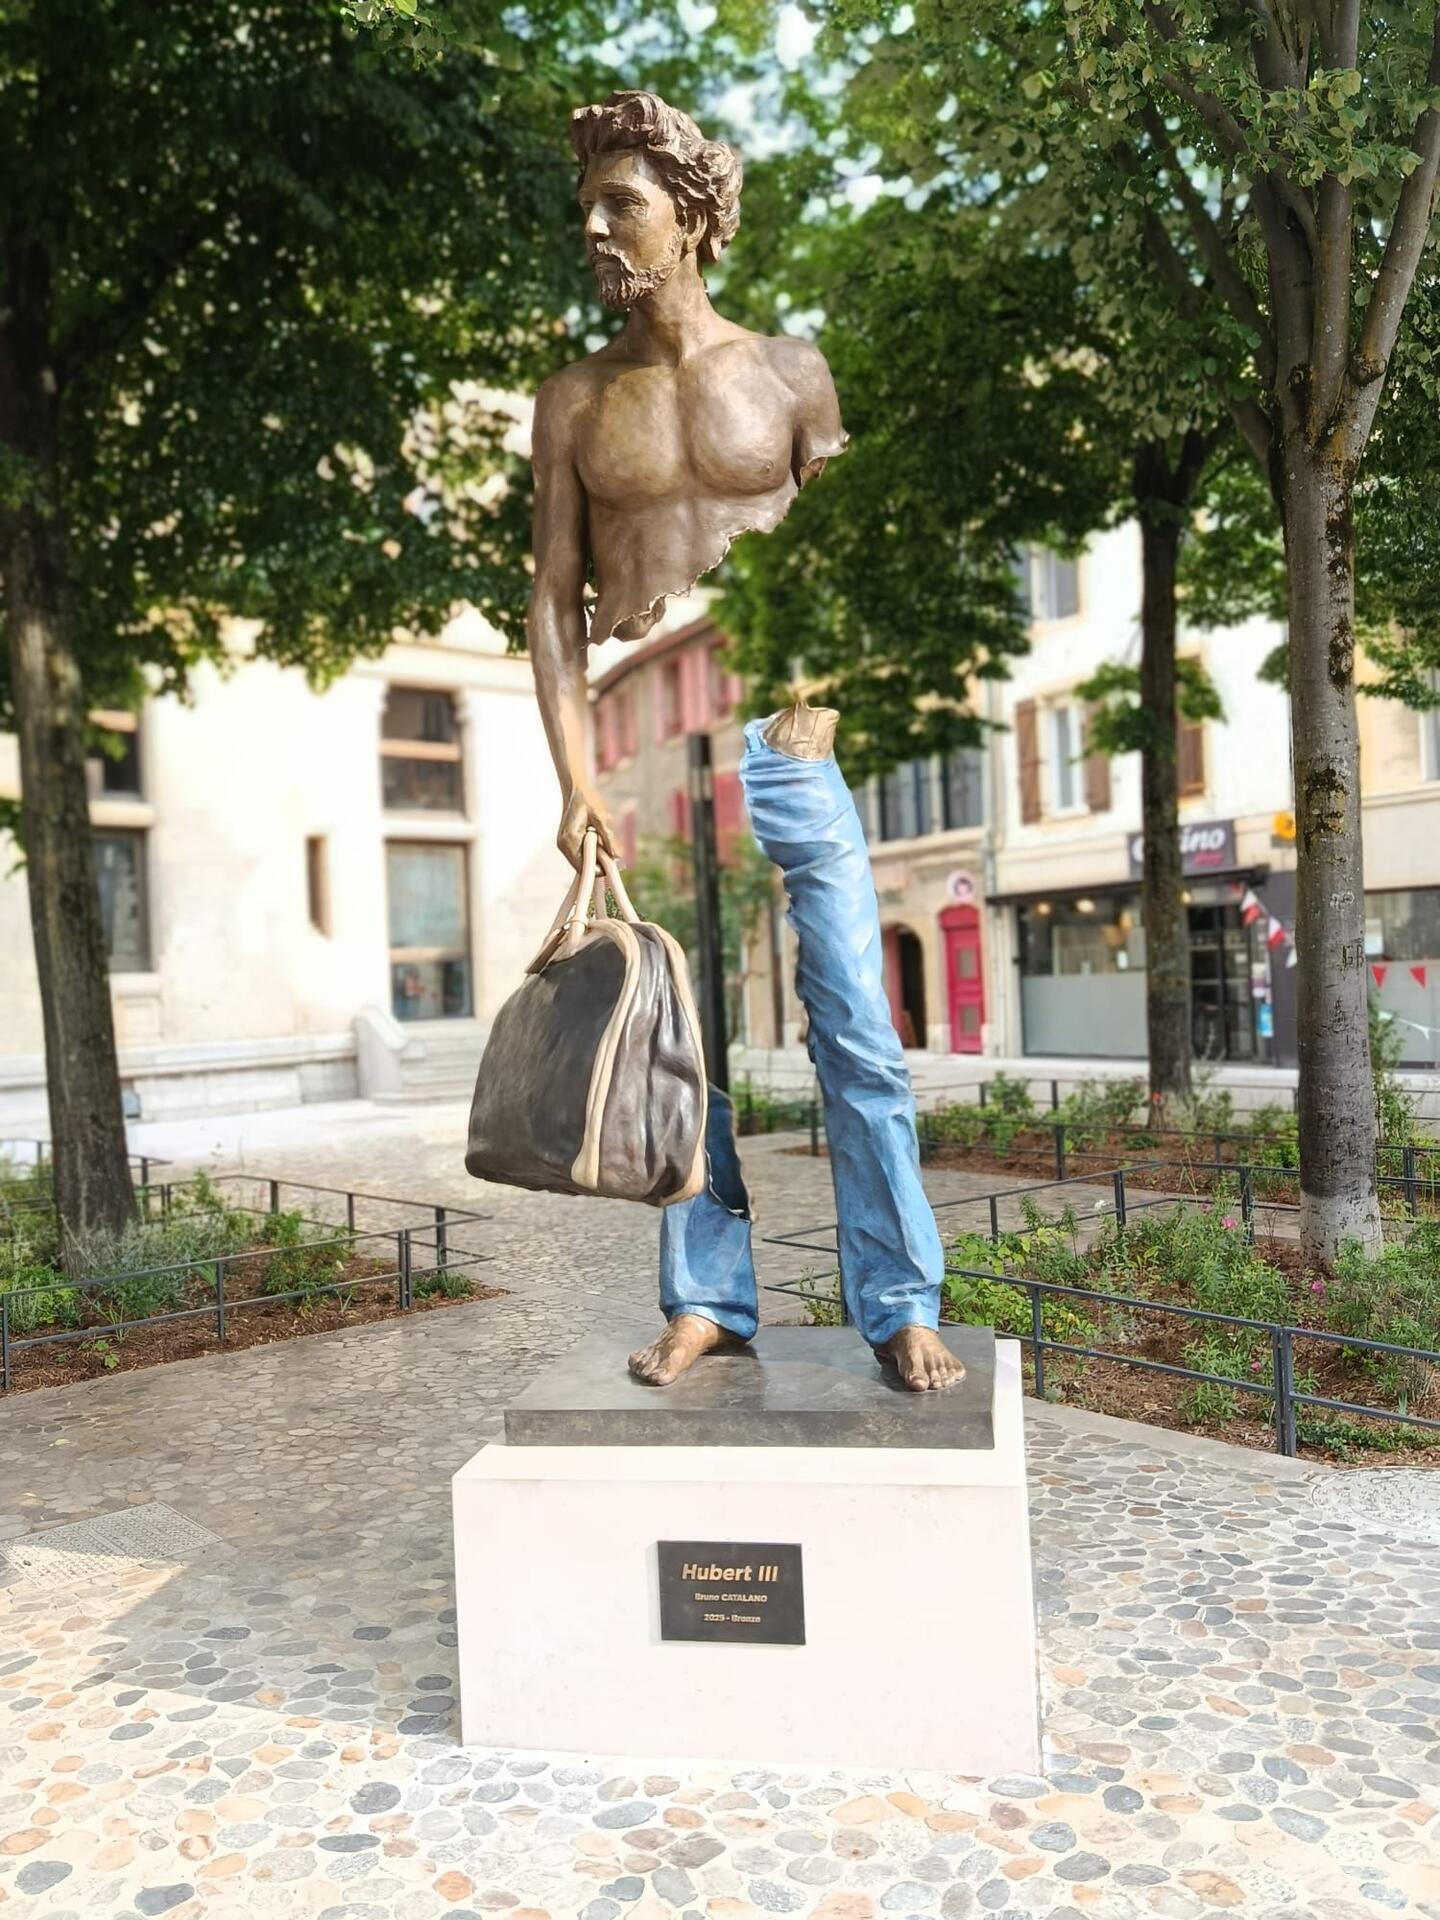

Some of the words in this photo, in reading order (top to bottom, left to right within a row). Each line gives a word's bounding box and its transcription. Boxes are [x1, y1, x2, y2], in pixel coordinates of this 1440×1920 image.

[682, 1563, 753, 1581] Hubert
[758, 1565, 779, 1582] III
[694, 1592, 720, 1601] Bruno
[721, 1593, 768, 1603] CATALANO
[731, 1614, 761, 1623] Bronze
